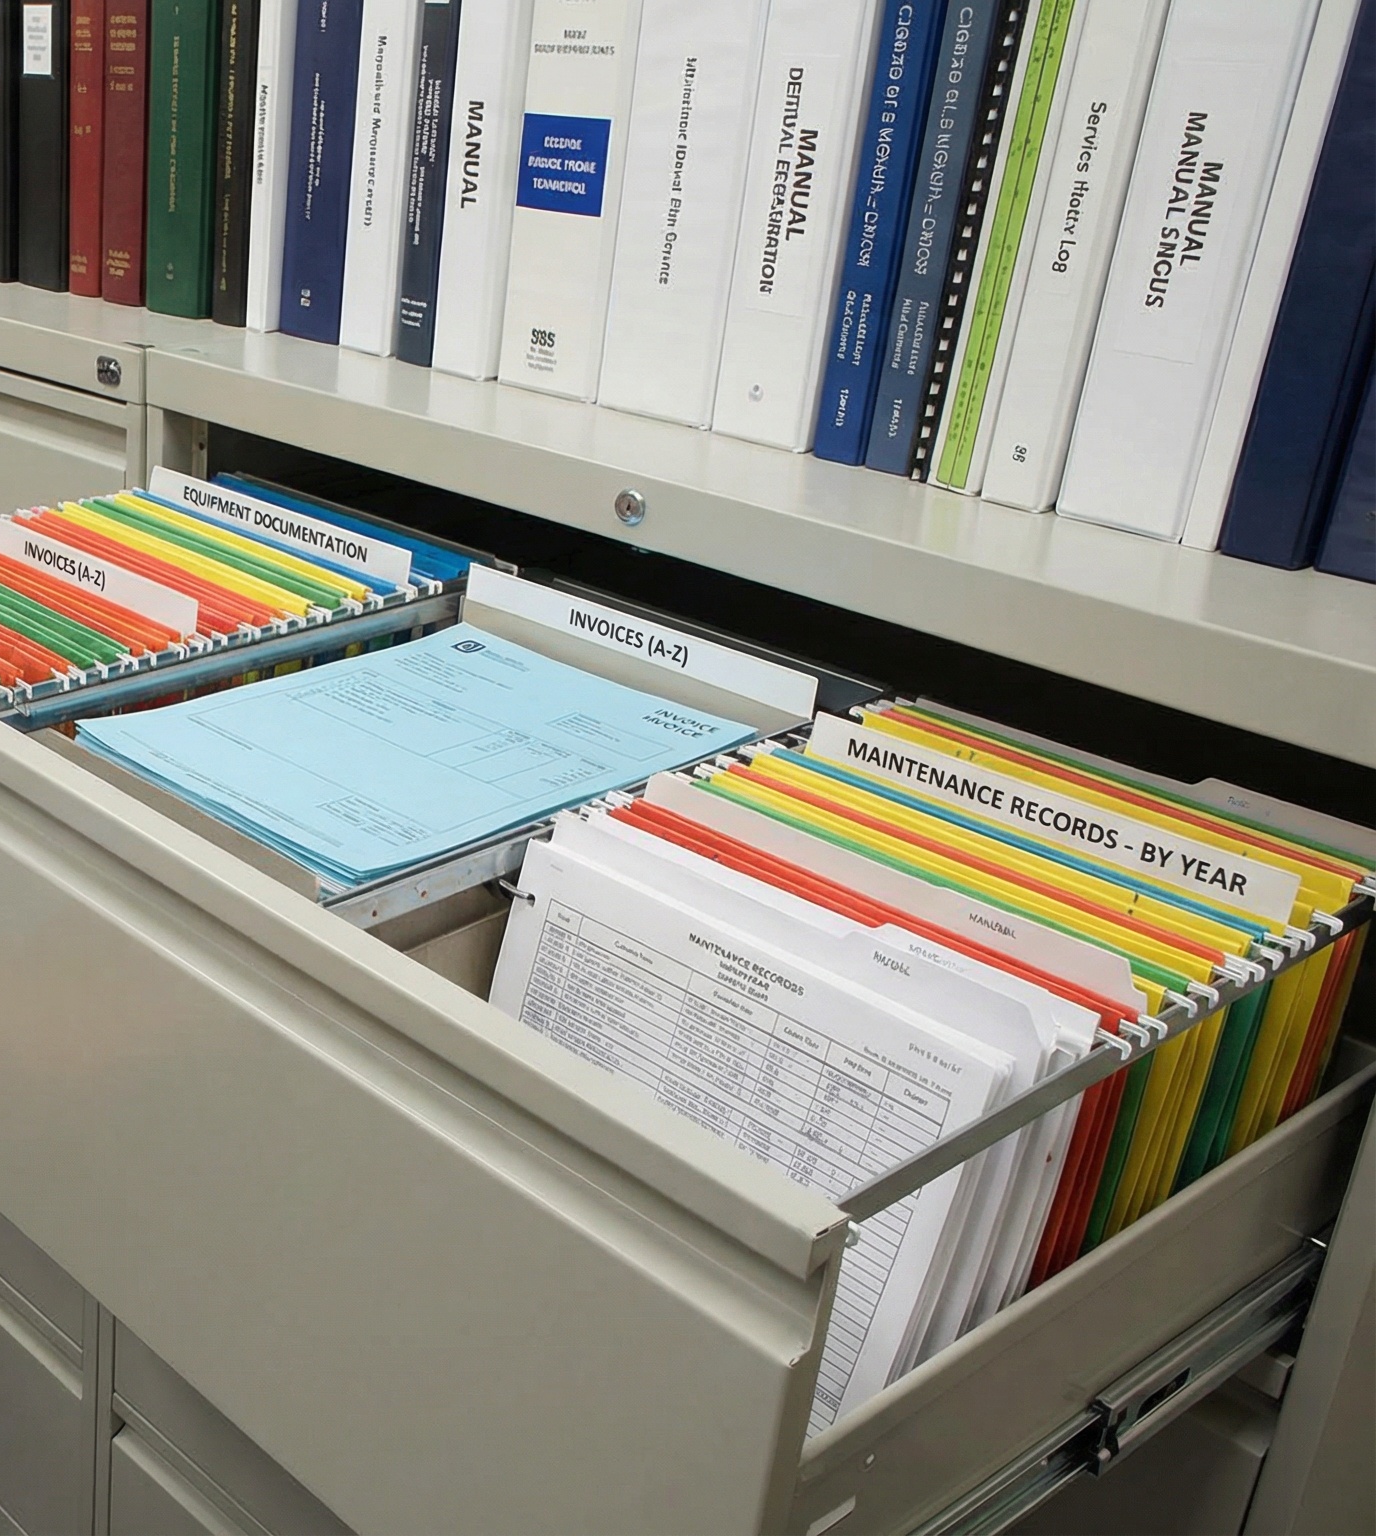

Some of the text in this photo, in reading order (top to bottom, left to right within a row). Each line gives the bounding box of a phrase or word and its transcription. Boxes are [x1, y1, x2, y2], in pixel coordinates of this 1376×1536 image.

[461, 100, 484, 209] MANUAL
[785, 129, 818, 241] MANUAL
[1166, 112, 1208, 220] MANUAL
[1180, 162, 1224, 267] MANUAL
[78, 562, 106, 592] (A-Z)
[254, 510, 368, 563] DOCUMENTATION
[569, 609, 688, 668] INVOICES (A-Z)
[654, 709, 720, 733] INVOICE
[847, 738, 1004, 810] MAINTENANCE
[1010, 796, 1119, 849] RECORDS
[1140, 842, 1174, 867] BY
[1181, 854, 1247, 896] YEAR
